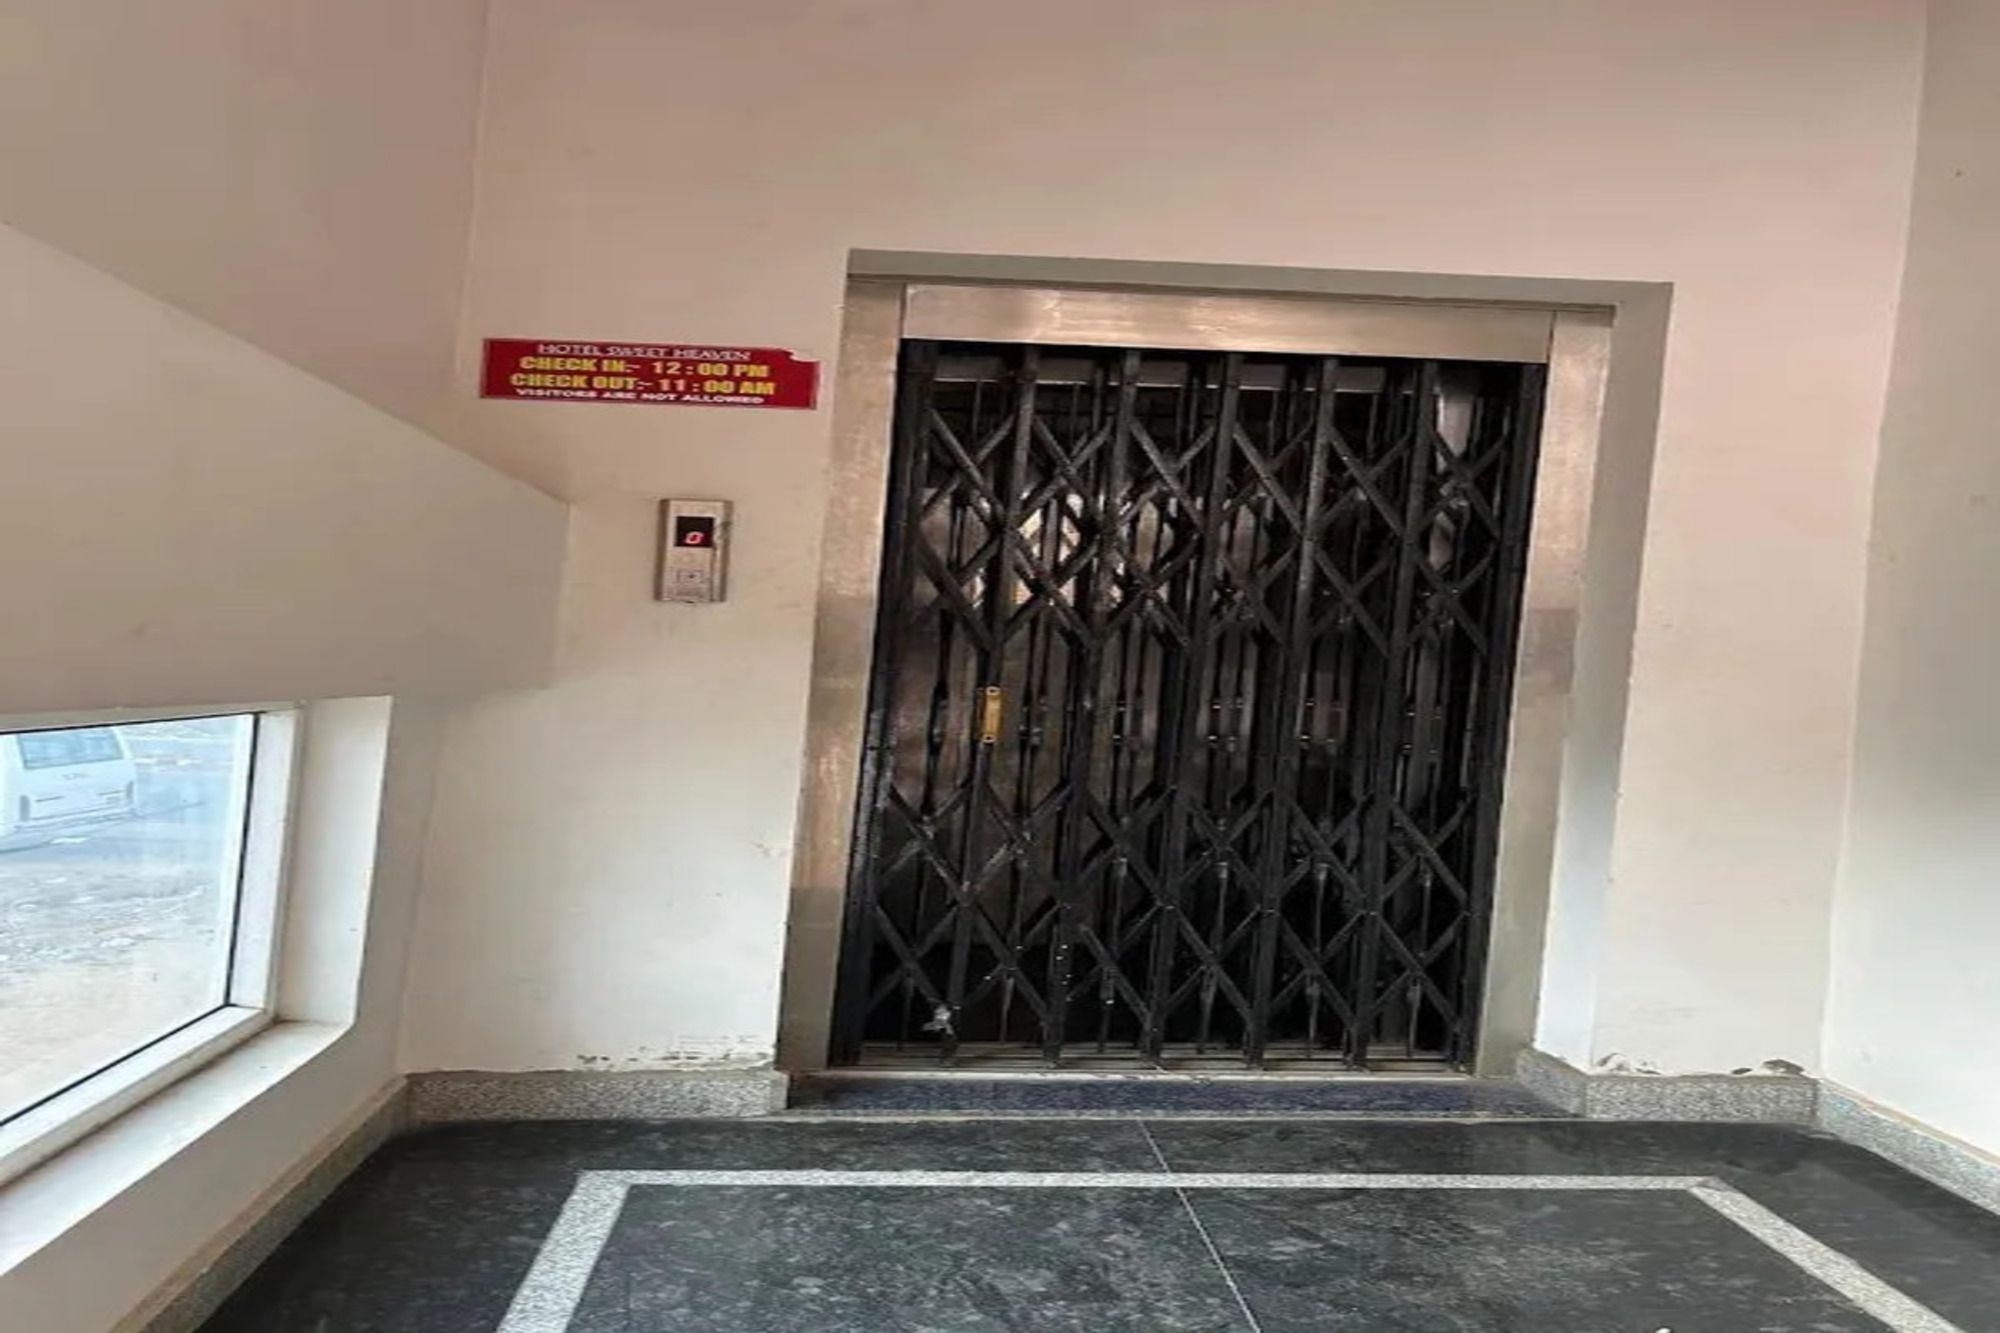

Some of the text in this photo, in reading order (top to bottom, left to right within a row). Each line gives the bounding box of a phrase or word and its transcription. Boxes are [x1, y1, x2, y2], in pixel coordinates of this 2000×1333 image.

[538, 344, 602, 356] HOTEL
[673, 350, 751, 361] HEAVEN
[520, 357, 597, 371] CHECK
[733, 364, 769, 377] PM
[510, 373, 589, 388] CHECK
[739, 381, 776, 395] AM
[515, 388, 765, 404] VISITORS ARE NOT ALLOWED
